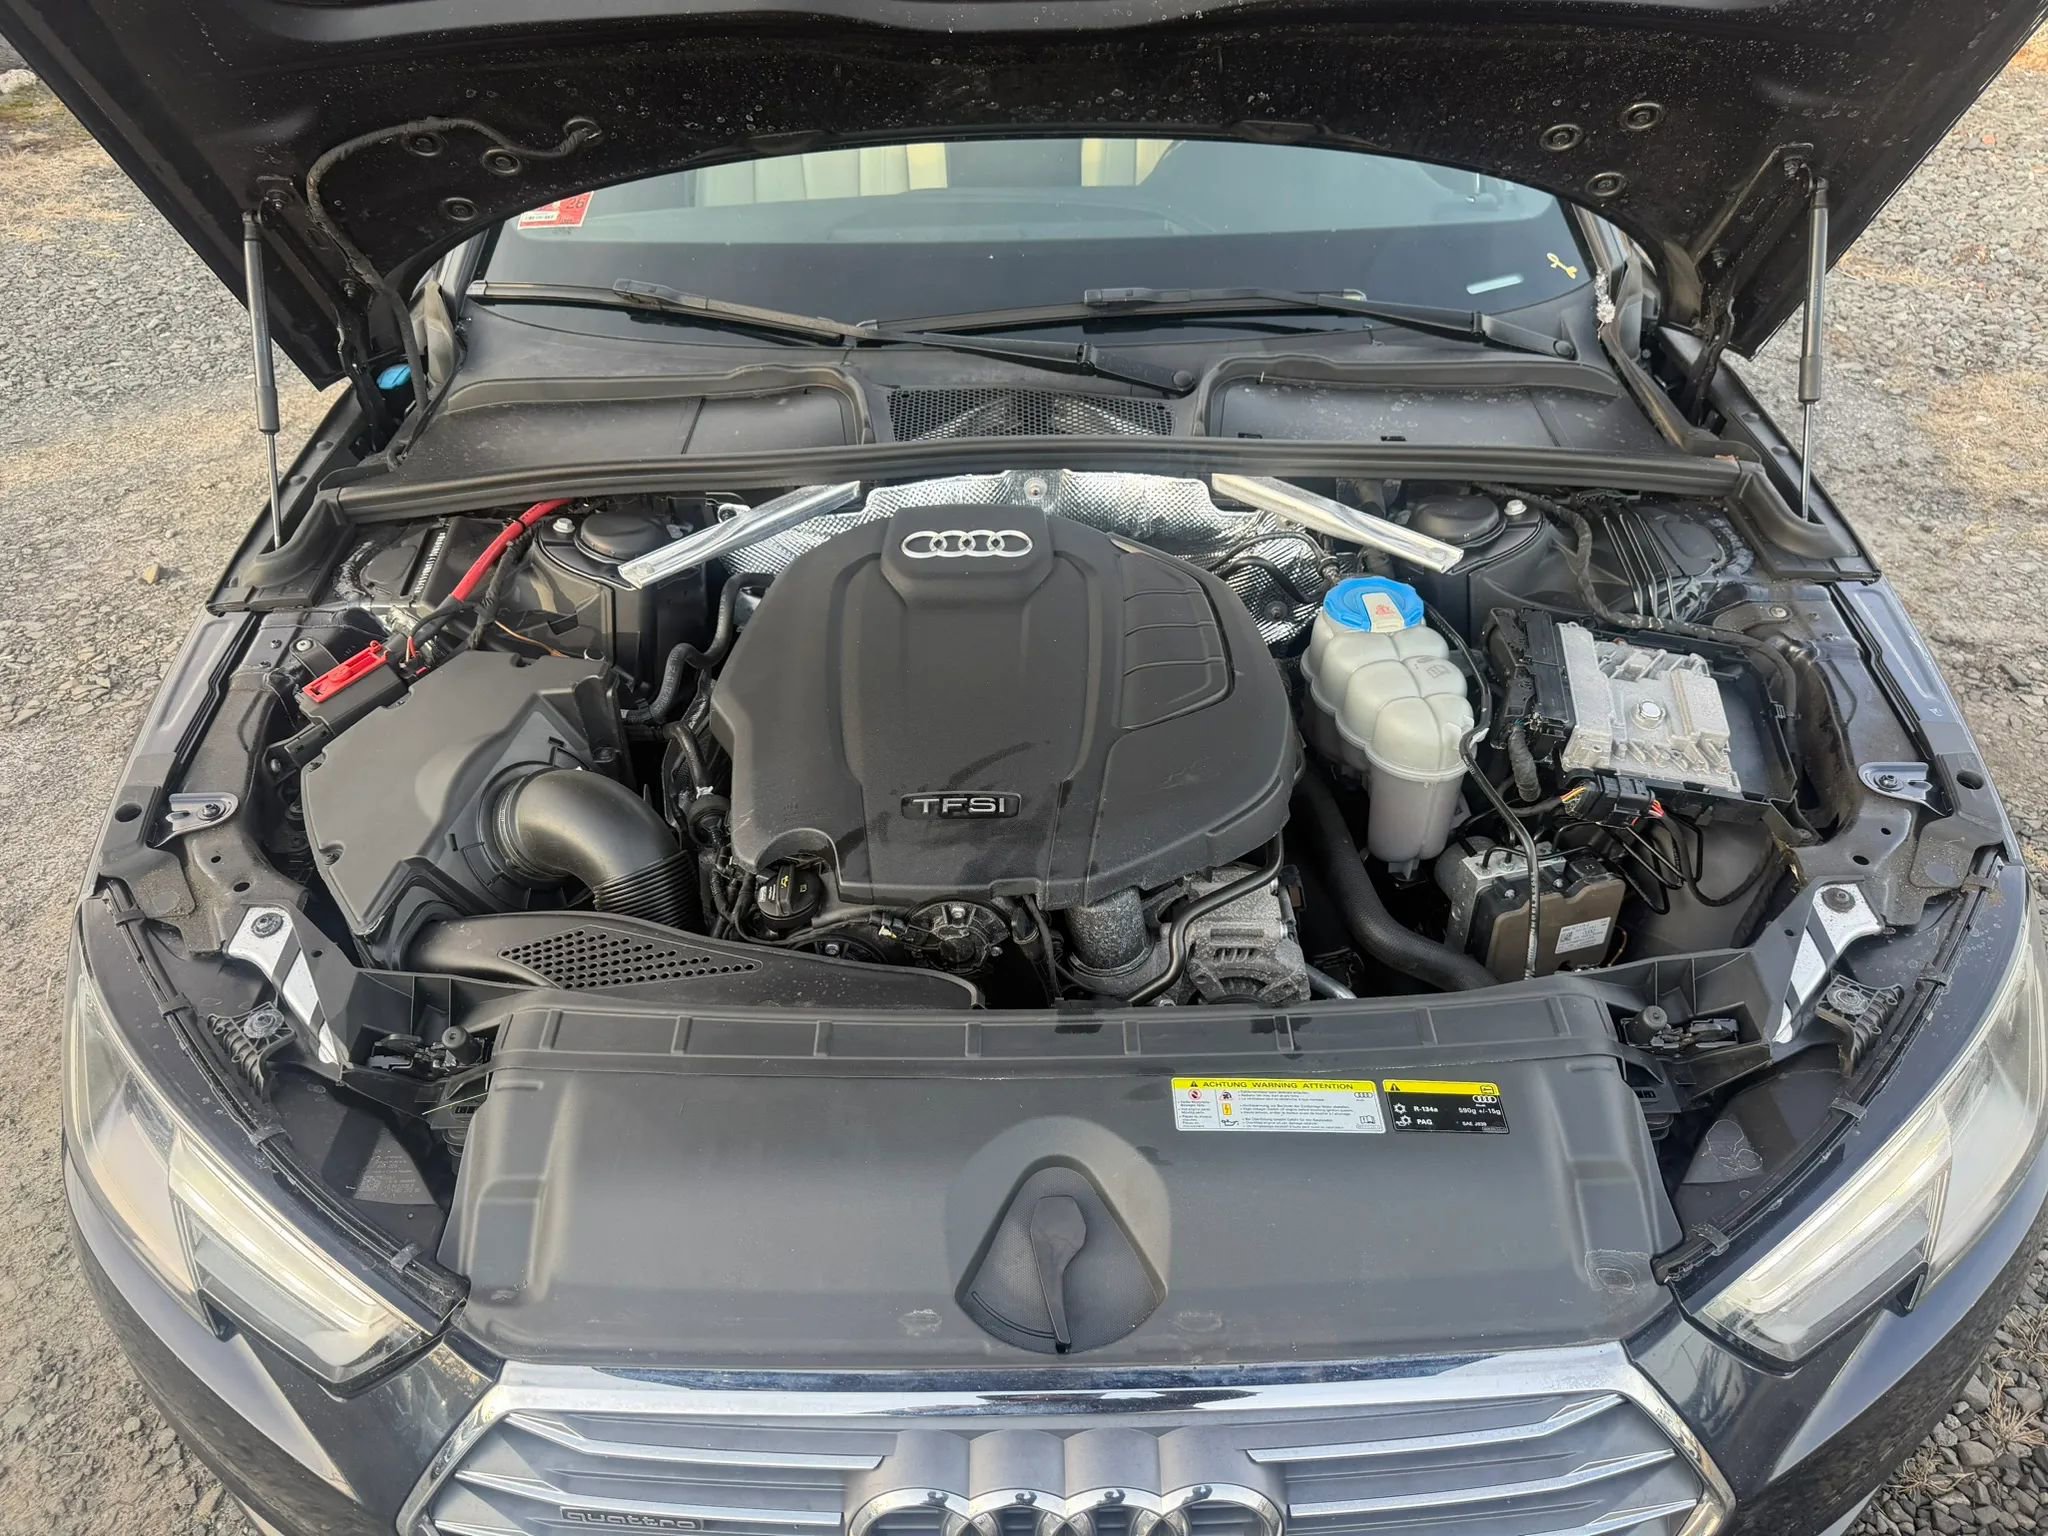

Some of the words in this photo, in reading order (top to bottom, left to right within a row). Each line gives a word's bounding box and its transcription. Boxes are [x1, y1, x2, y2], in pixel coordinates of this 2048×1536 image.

[912, 797, 1005, 813] TFSI
[1413, 1105, 1439, 1113] R-134a
[1416, 1118, 1433, 1126] PAG
[566, 1511, 696, 1529] quattro
